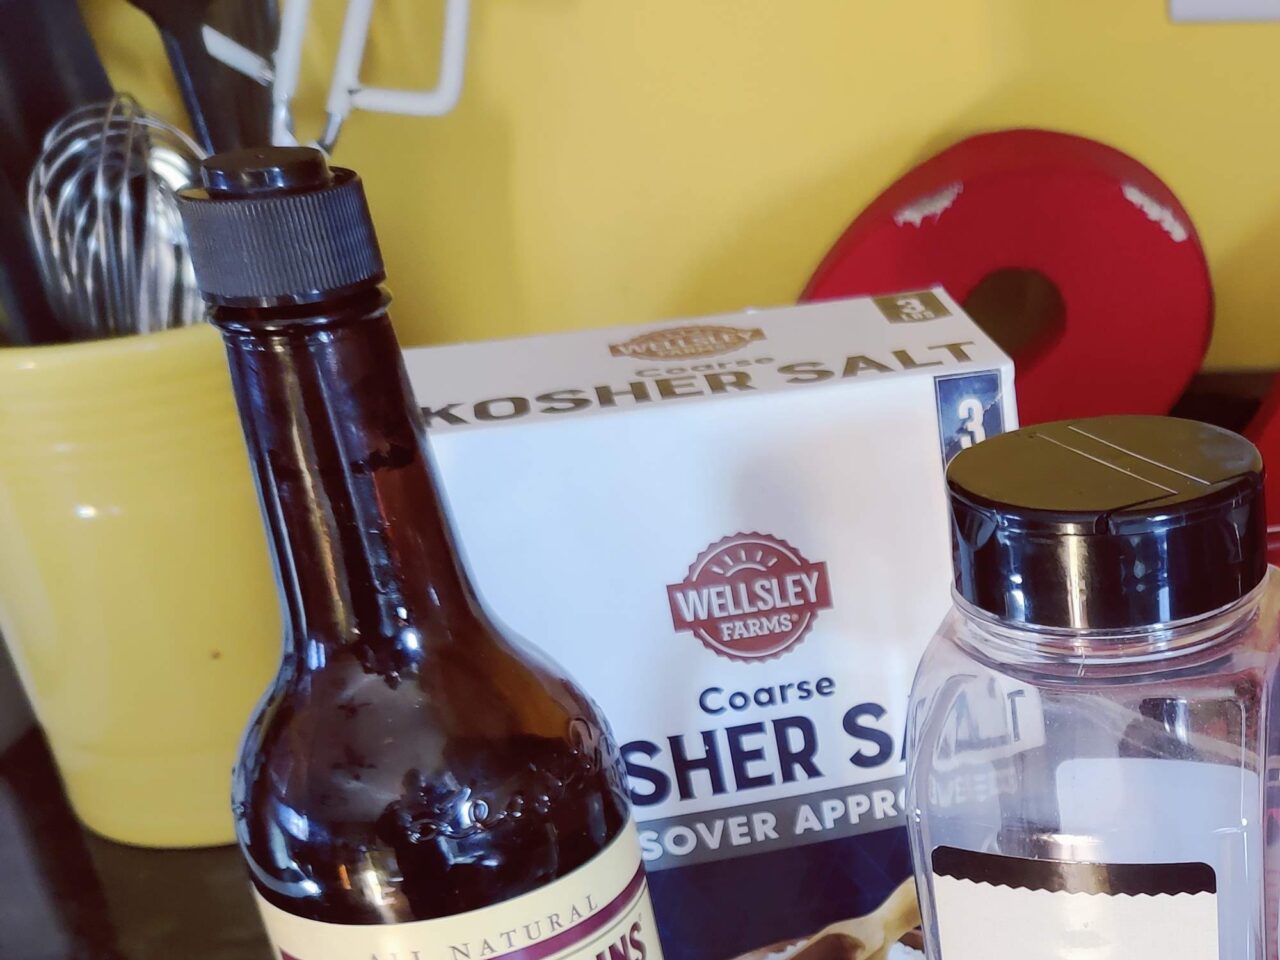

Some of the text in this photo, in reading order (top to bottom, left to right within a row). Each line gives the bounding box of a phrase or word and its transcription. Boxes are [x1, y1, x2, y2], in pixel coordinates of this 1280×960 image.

[421, 341, 975, 429] KOSHER SALT
[634, 357, 775, 378] Coarse
[677, 571, 819, 623] WELLSLEY
[721, 614, 794, 642] FARMS
[699, 676, 836, 716] Coarse
[620, 714, 824, 808] SHER
[637, 810, 780, 862] SOVER
